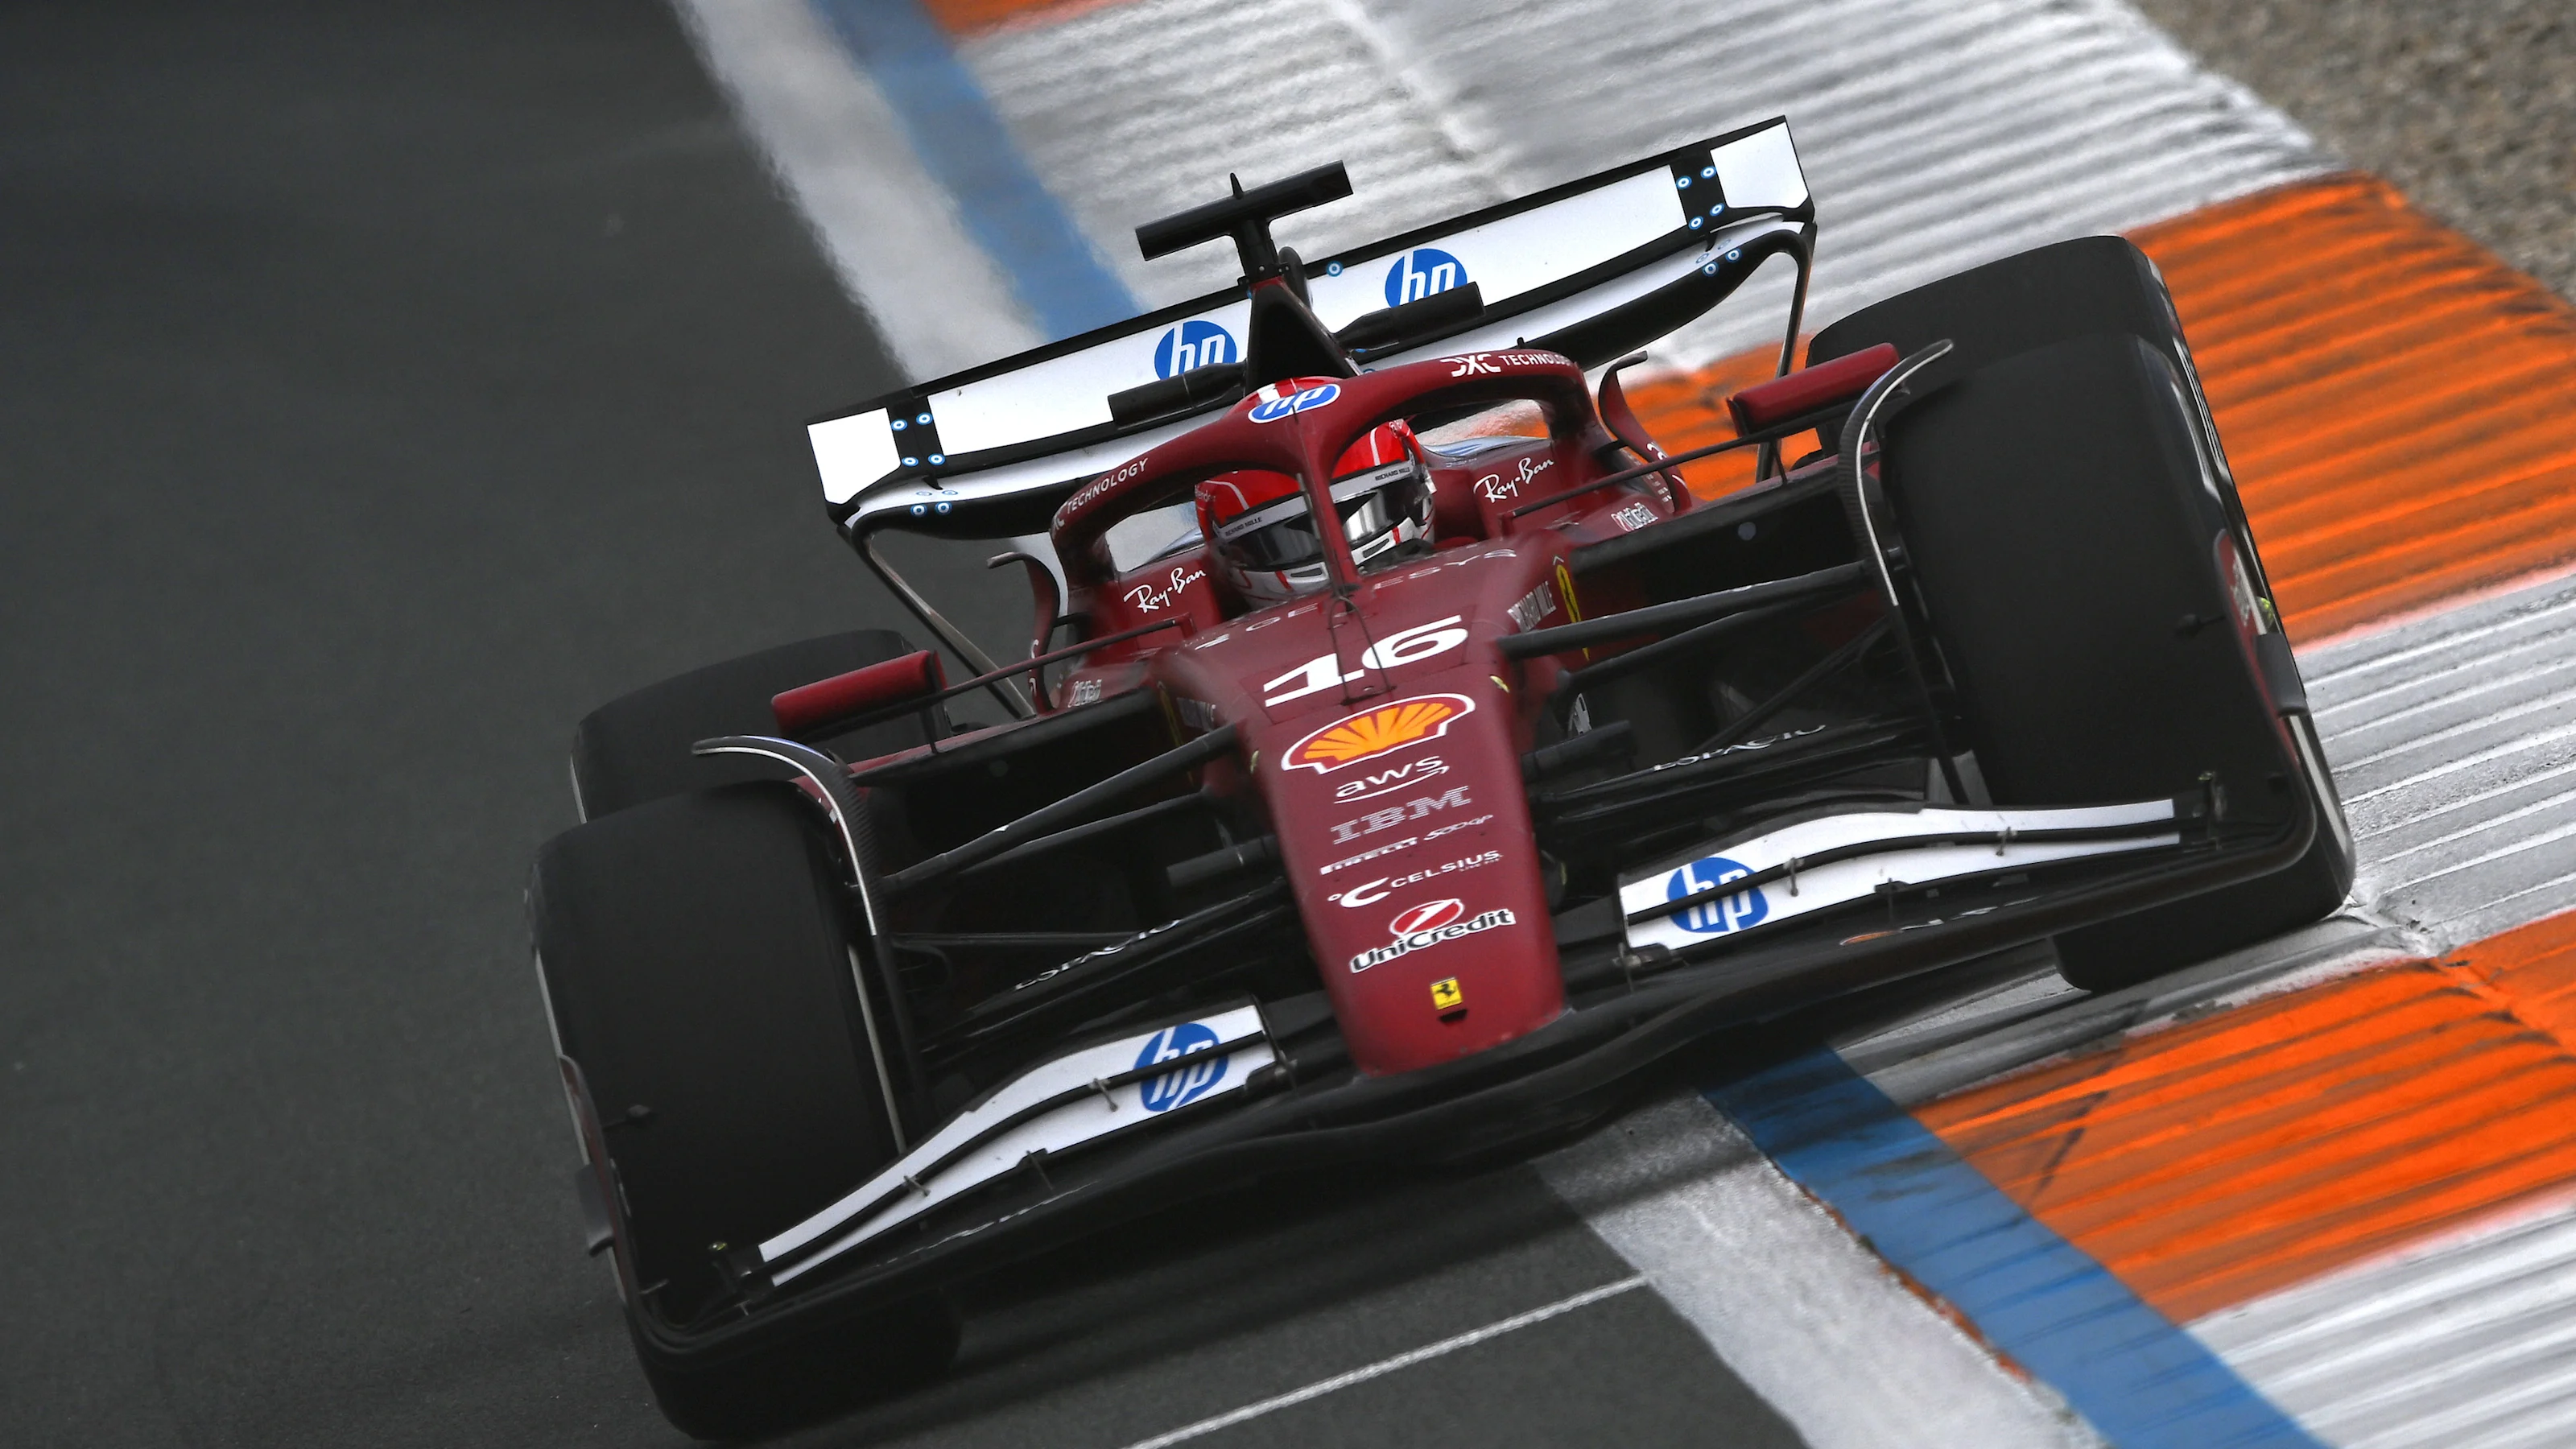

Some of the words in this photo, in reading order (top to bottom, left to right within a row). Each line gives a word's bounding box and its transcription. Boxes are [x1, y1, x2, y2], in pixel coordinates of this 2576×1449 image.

[1439, 353, 1501, 378] DXC
[1067, 457, 1149, 514] TECHNOLOGY
[1263, 614, 1469, 708] 16
[1335, 754, 1444, 799] aws
[1330, 785, 1473, 845] IBM
[1319, 836, 1418, 876] PIRELLI
[1390, 850, 1502, 888] CELSIUS
[1680, 862, 1754, 933] hp
[1352, 910, 1514, 972] UniCredit
[1148, 1026, 1219, 1112] hp
